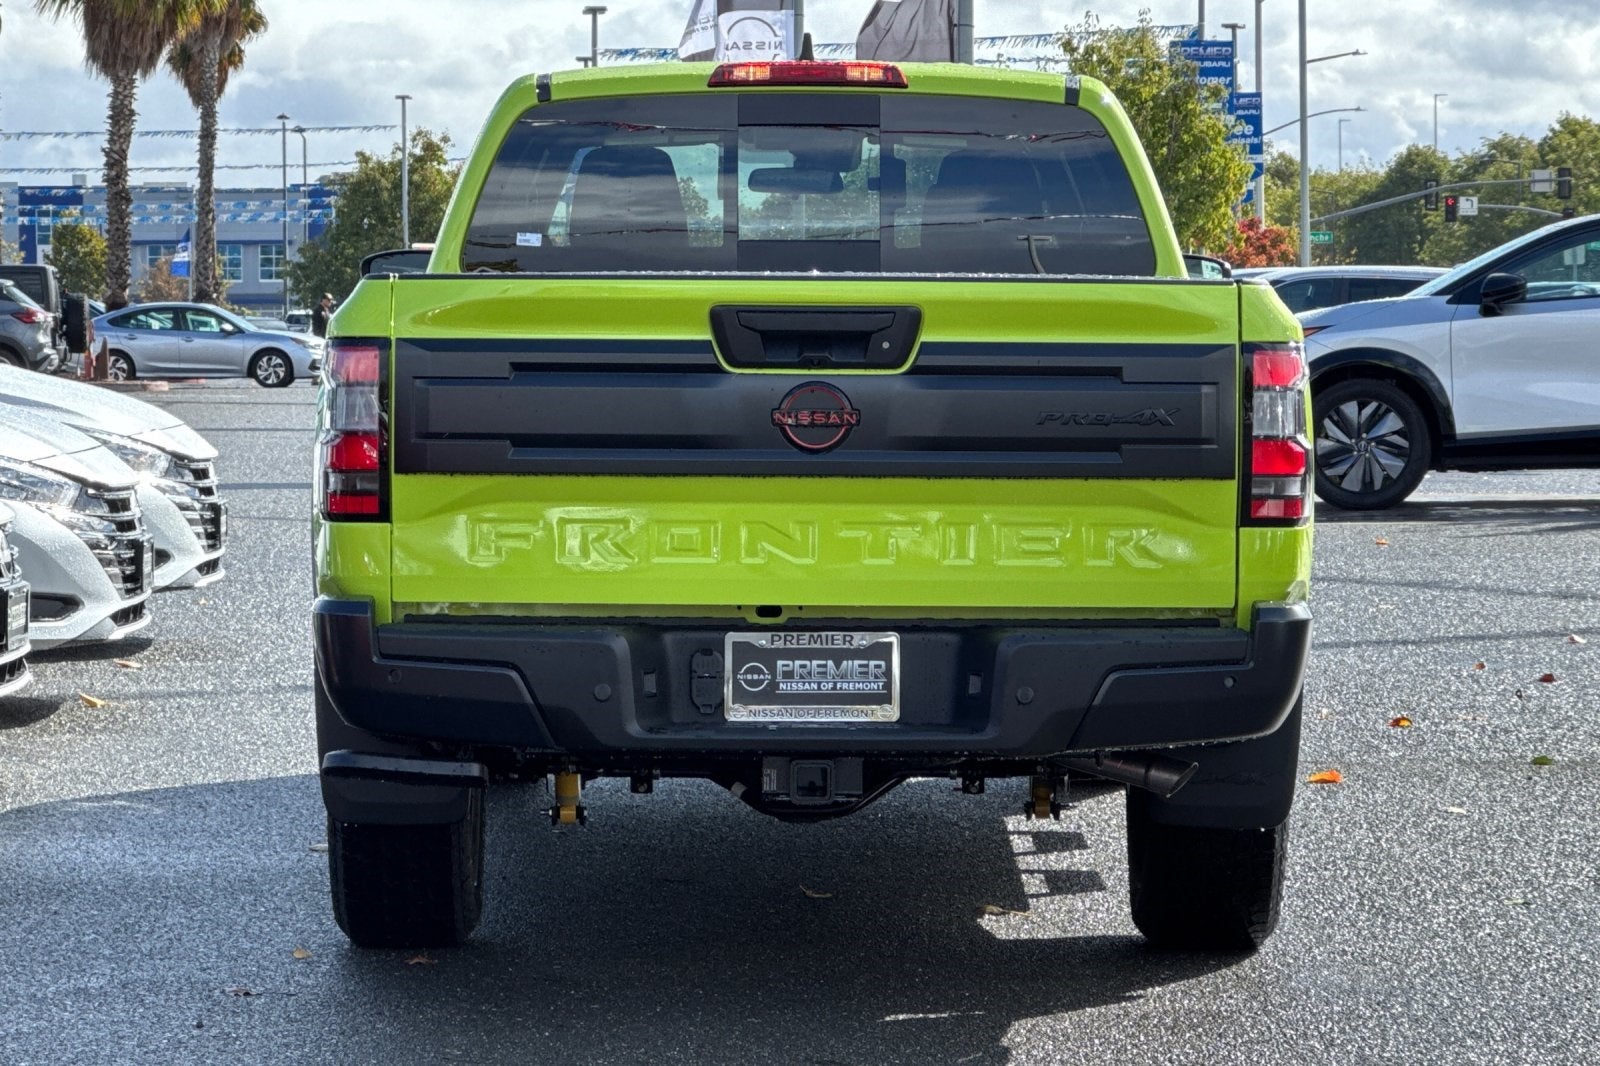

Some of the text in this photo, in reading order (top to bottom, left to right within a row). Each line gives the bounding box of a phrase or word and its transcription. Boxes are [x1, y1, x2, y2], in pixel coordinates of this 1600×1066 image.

[773, 410, 858, 425] NISSAN
[1035, 407, 1182, 427] PRO-4X
[466, 517, 1164, 570] FRONTIER
[770, 633, 855, 647] PREMIER
[776, 659, 887, 680] PREMIER
[779, 682, 884, 691] NISSAN OF FREMONT
[749, 708, 877, 719] NISSAN OF FREMONT
